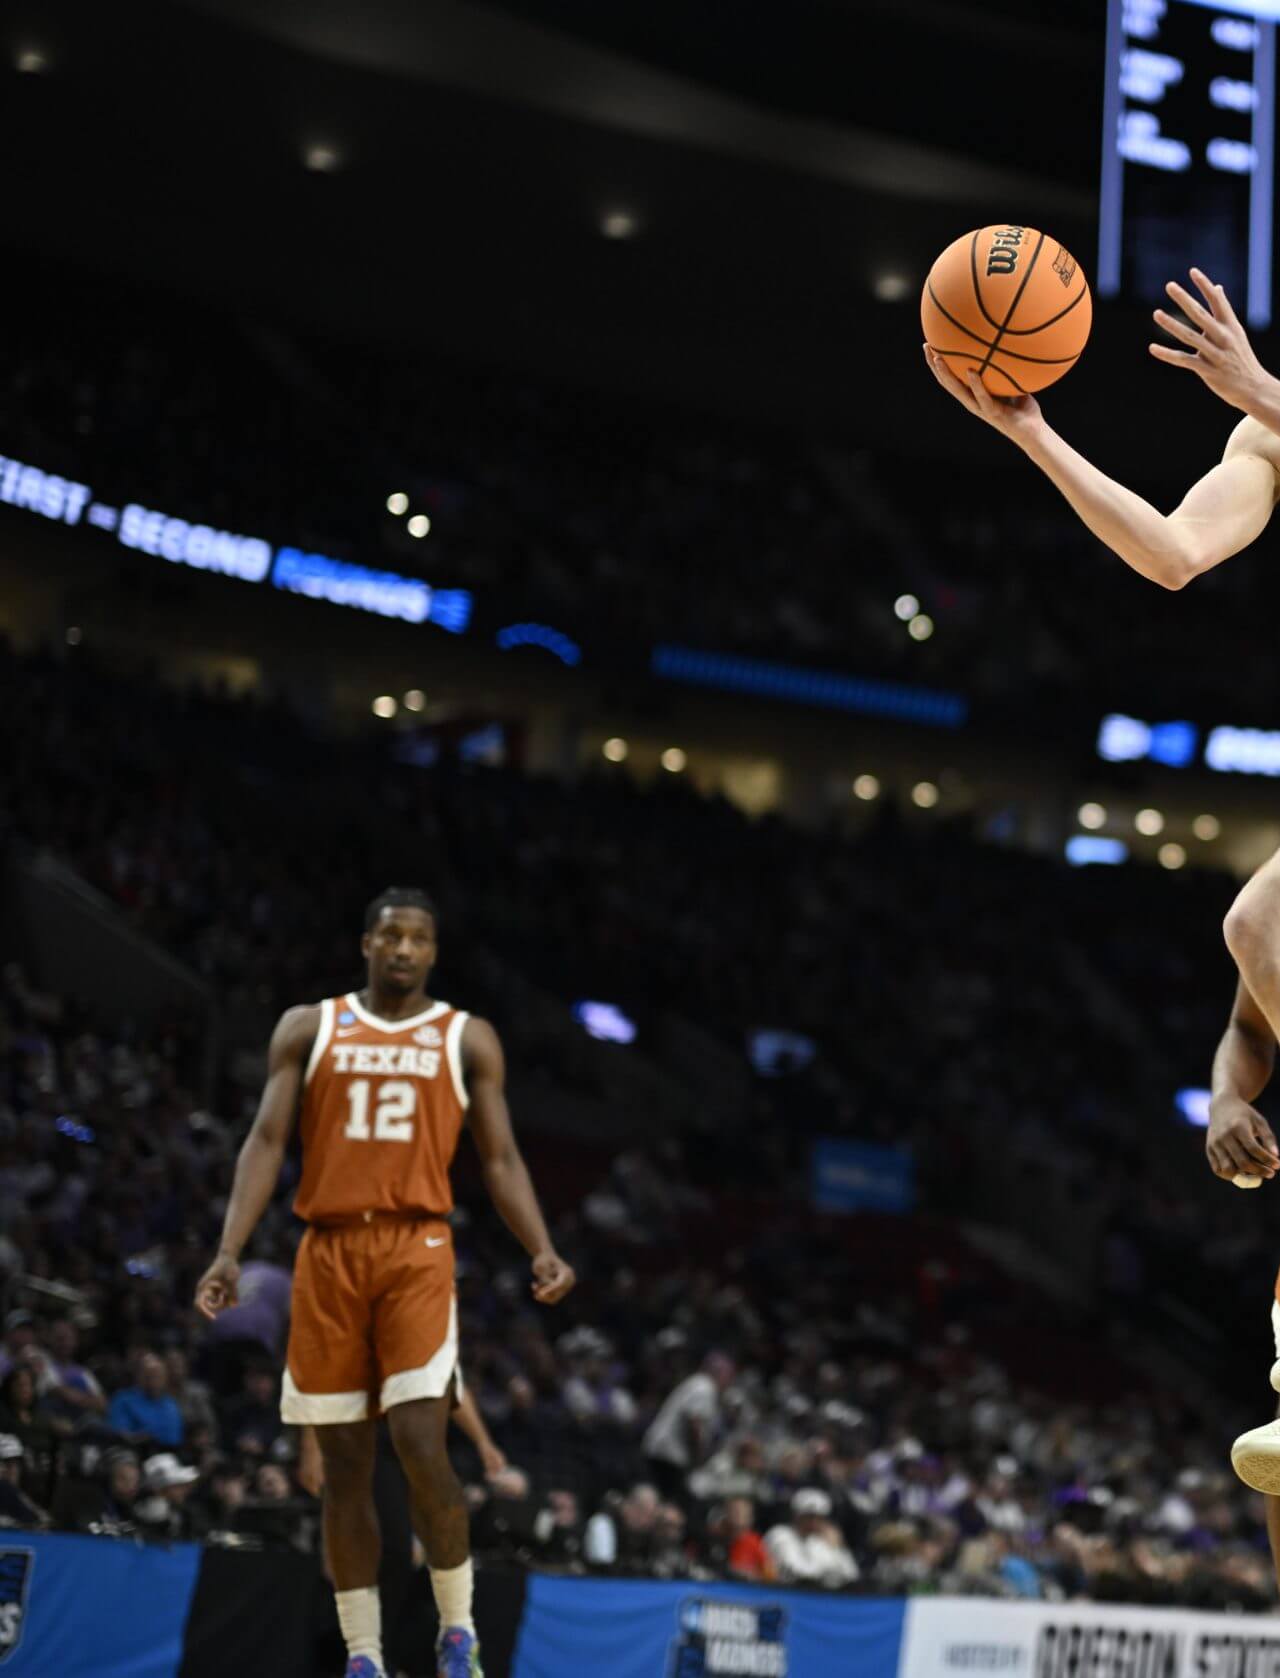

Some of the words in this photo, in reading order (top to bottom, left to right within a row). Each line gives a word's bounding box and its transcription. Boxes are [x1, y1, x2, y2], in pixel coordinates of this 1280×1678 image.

[119, 503, 271, 582] SECOND
[332, 1044, 440, 1079] TEXAS
[344, 1079, 417, 1142] 12
